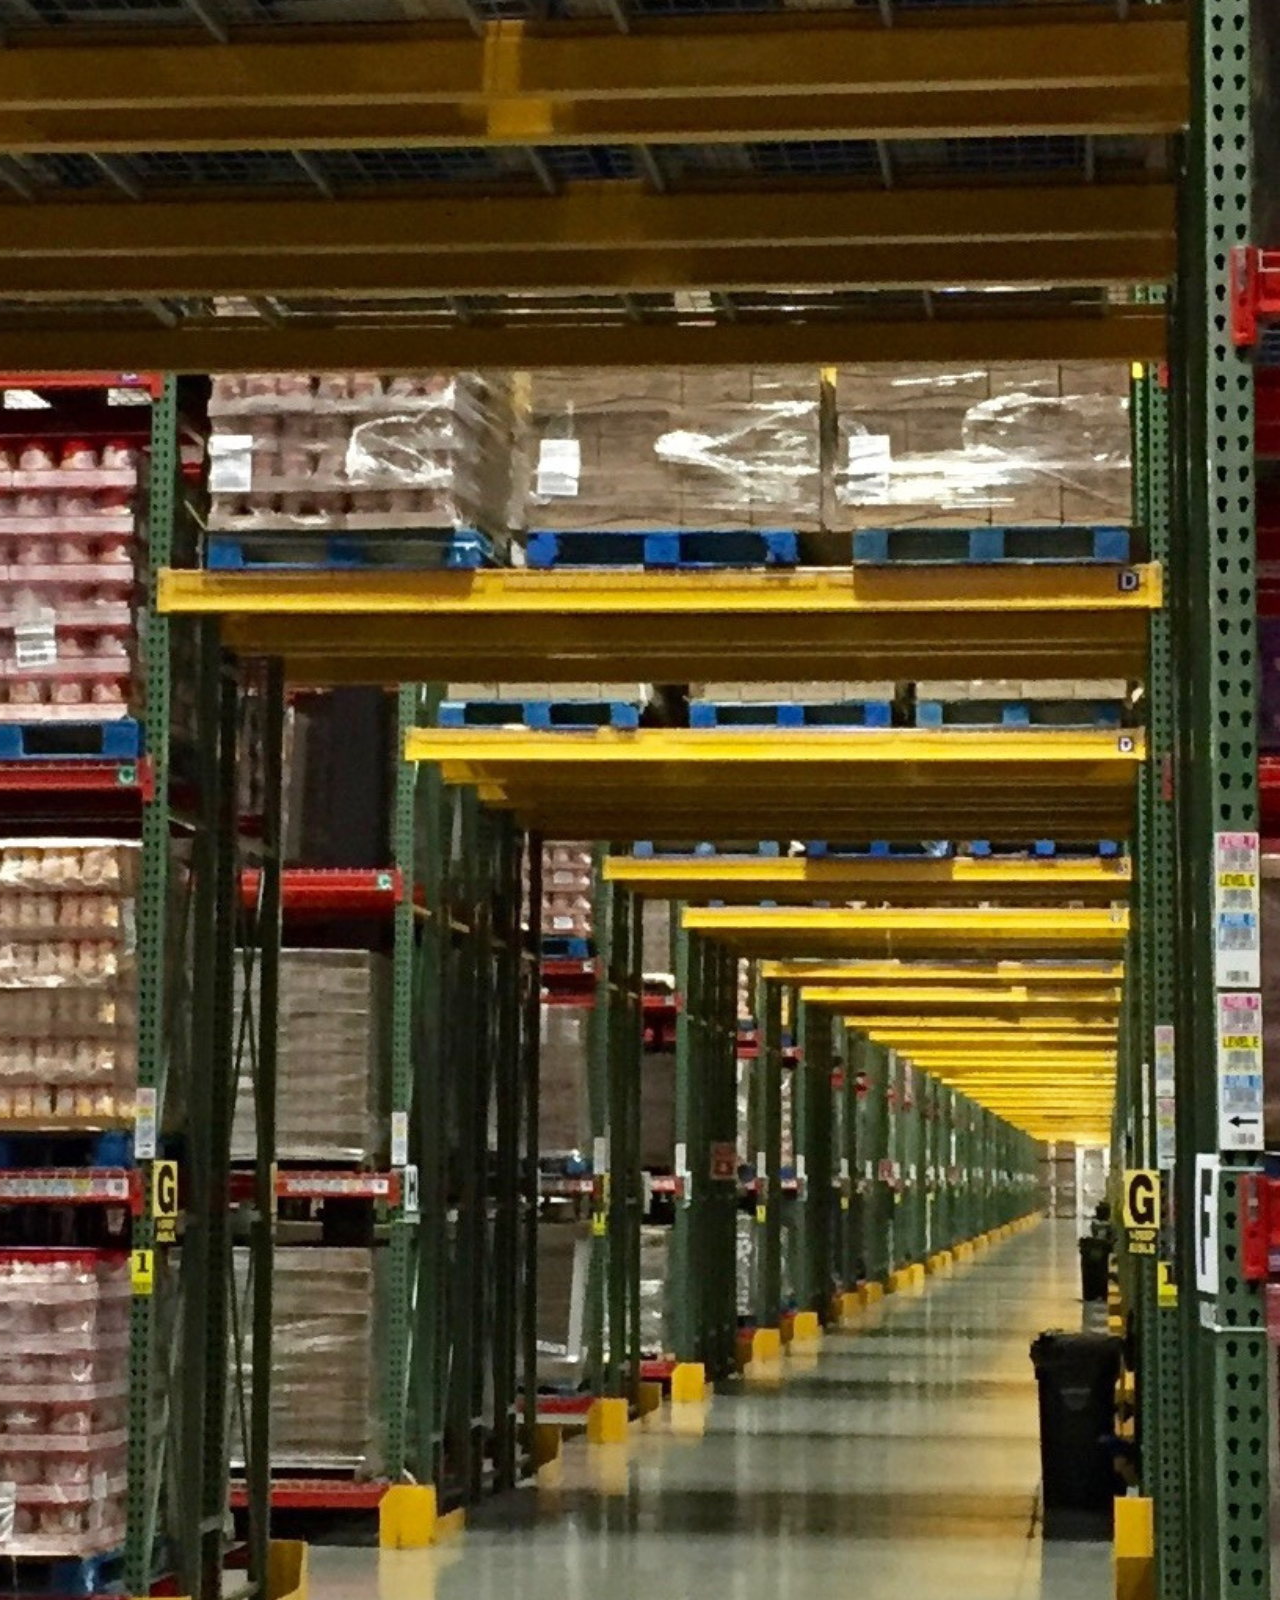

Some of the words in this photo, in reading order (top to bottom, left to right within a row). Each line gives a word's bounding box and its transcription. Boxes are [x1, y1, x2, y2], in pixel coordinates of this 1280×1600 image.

[1121, 571, 1137, 590] D
[158, 1164, 175, 1215] G
[1129, 1174, 1154, 1224] G
[1200, 1169, 1213, 1275] F
[136, 1252, 150, 1273] 1
